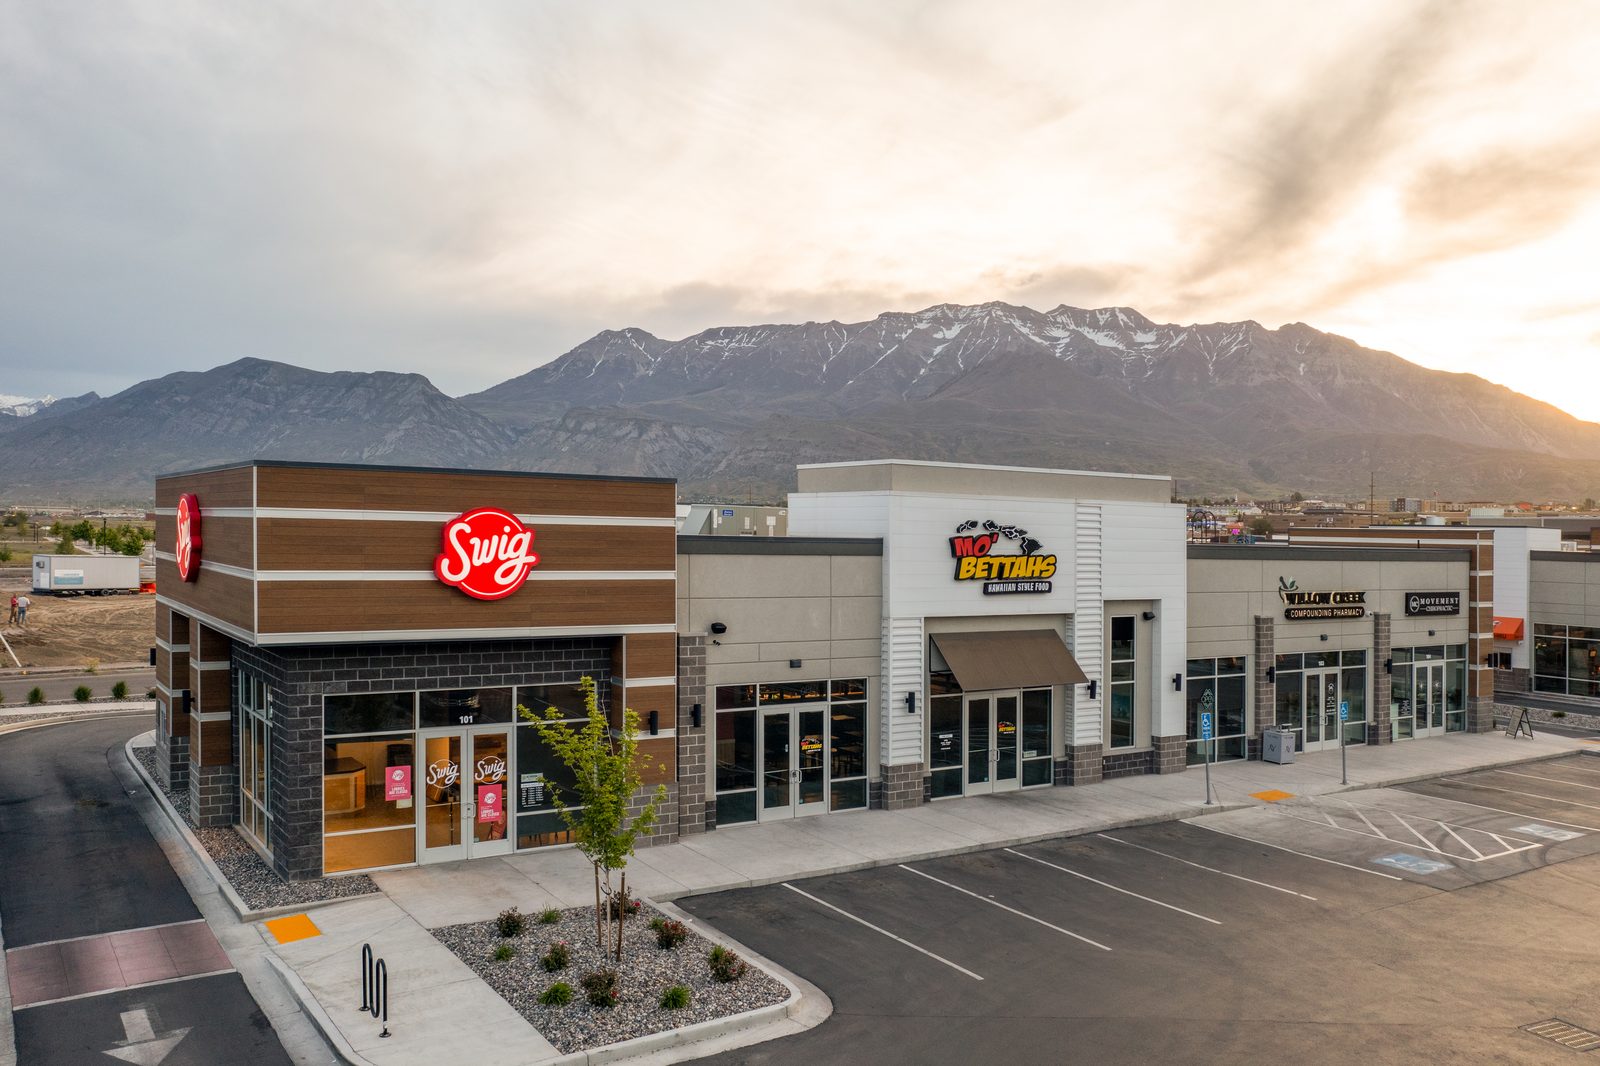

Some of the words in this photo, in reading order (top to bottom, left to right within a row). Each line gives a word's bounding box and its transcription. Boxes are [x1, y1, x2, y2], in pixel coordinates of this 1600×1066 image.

[440, 522, 536, 585] Swig
[953, 532, 999, 557] MO'
[958, 555, 1057, 579] BETTAHS
[988, 583, 1016, 592] HAWAIIAN
[1018, 583, 1034, 592] STYLE
[1035, 582, 1049, 591] FOOD
[1290, 609, 1332, 618] COMPOUNDING
[459, 716, 473, 724] 101
[426, 763, 460, 784] Swig
[474, 760, 506, 780] Swig
